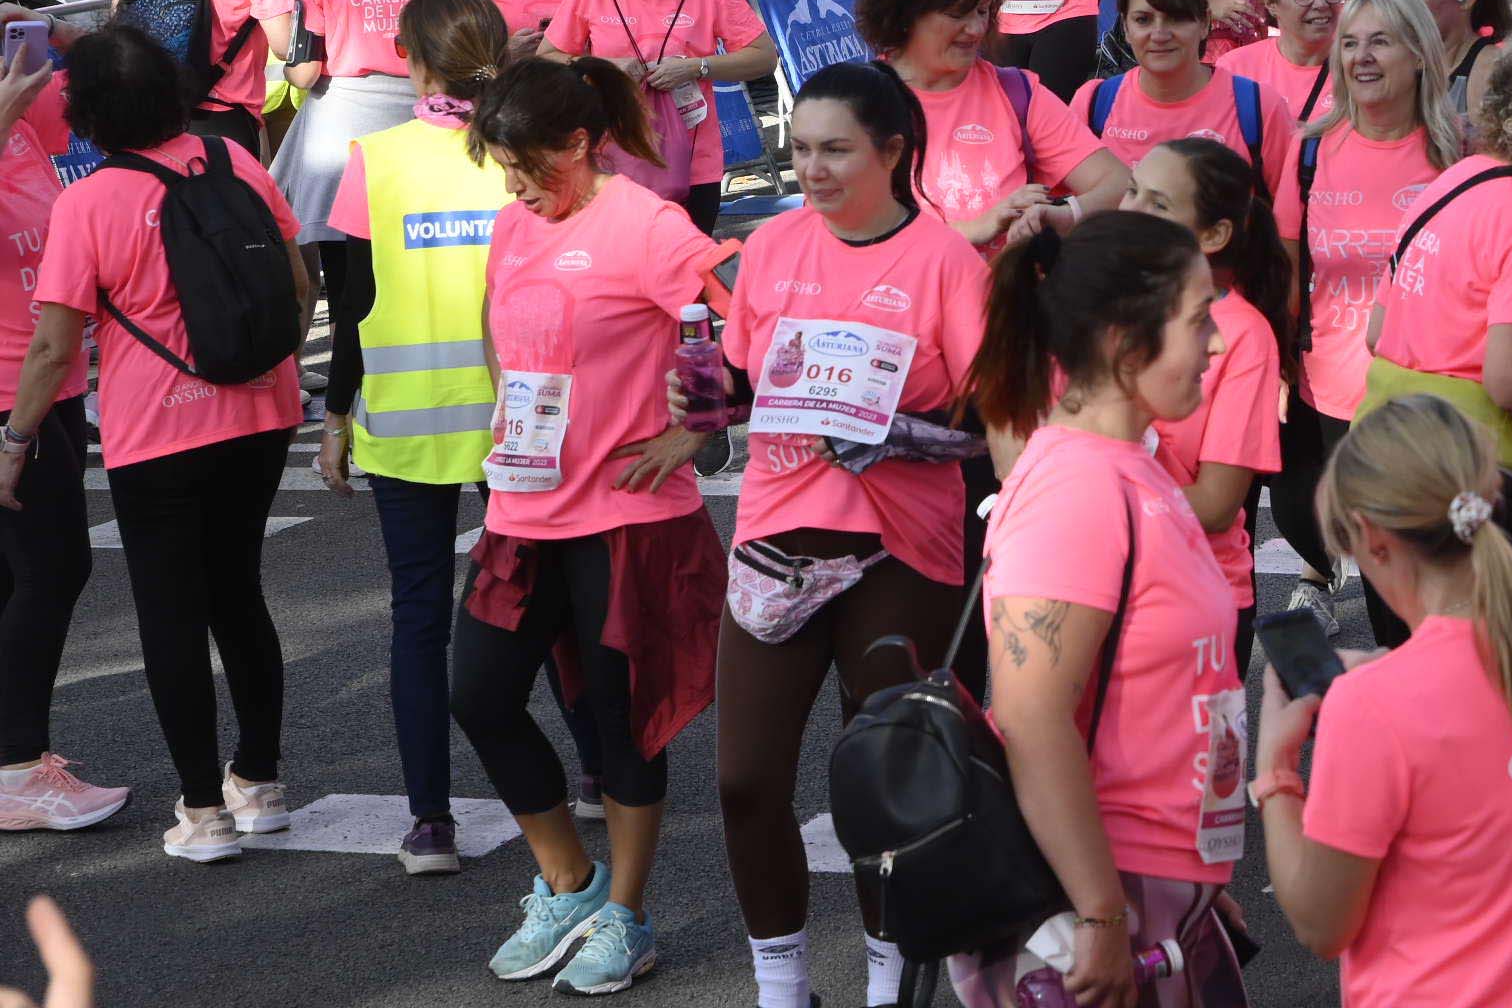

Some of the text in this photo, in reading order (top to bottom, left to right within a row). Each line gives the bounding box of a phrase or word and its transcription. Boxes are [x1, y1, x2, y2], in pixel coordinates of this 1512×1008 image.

[364, 5, 384, 19] DE
[9, 226, 42, 257] TU
[775, 279, 822, 296] OYSHO
[815, 335, 864, 355] ASTURIANA
[806, 364, 853, 384] 016
[162, 383, 217, 408] OYSHO
[808, 384, 838, 398] 6295
[760, 414, 801, 425] OYSHO
[767, 398, 877, 422] CARRERA DE LA MUJER 2023
[506, 418, 524, 436] 16
[831, 419, 876, 438] Santander
[1192, 635, 1227, 677] TU
[762, 950, 803, 961] umbro
